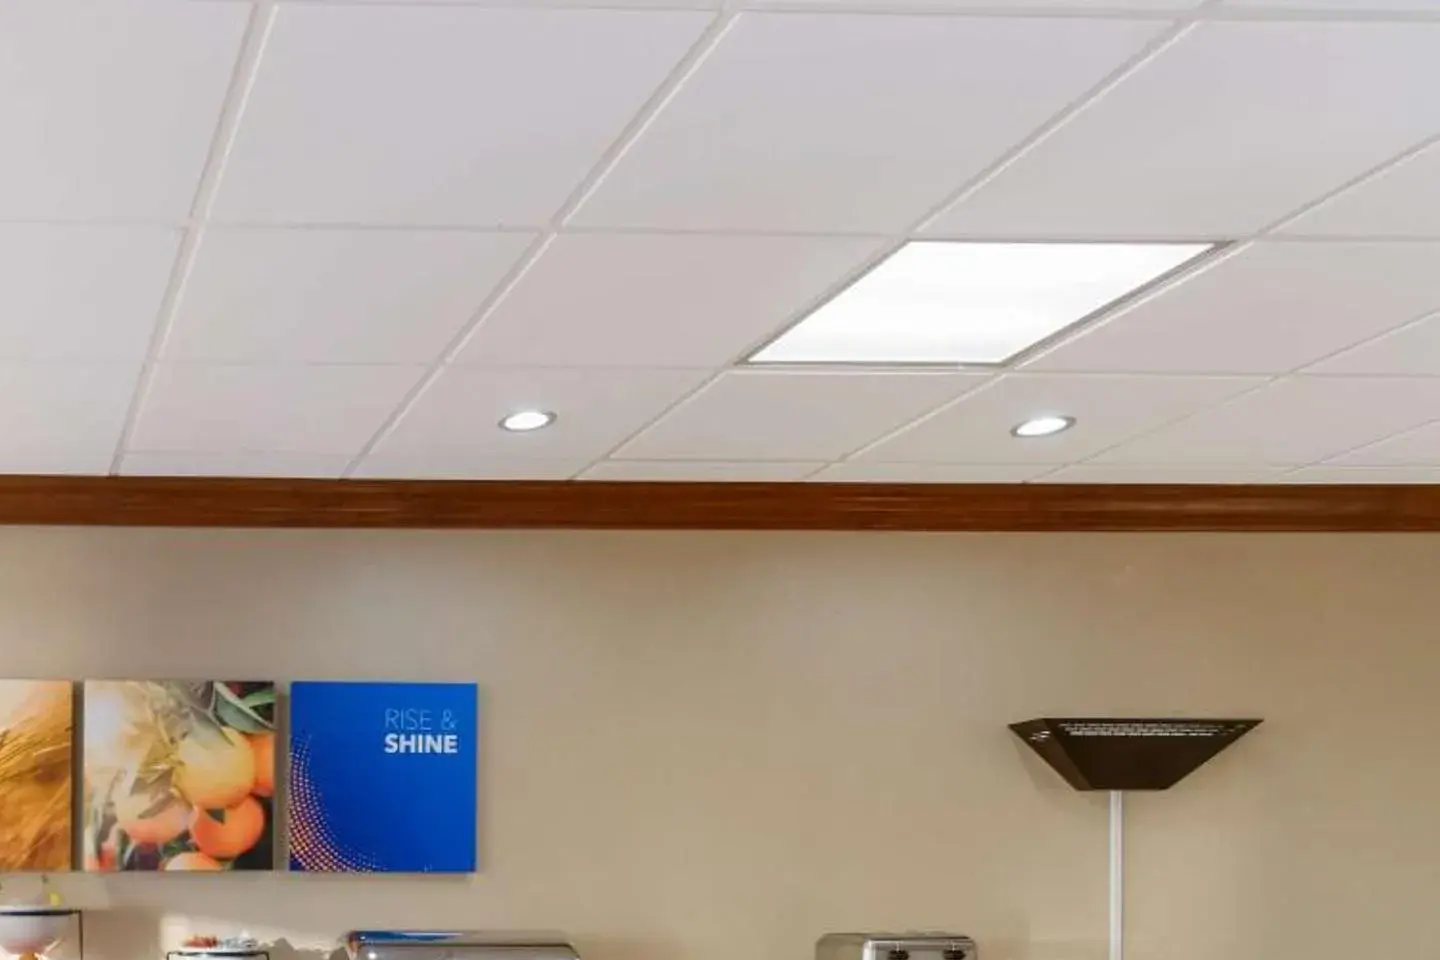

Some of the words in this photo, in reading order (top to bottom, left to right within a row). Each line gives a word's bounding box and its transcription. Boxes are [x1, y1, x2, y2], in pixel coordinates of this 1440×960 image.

[384, 709, 432, 730] RISE
[441, 709, 458, 730] &
[384, 733, 458, 754] SHINE
